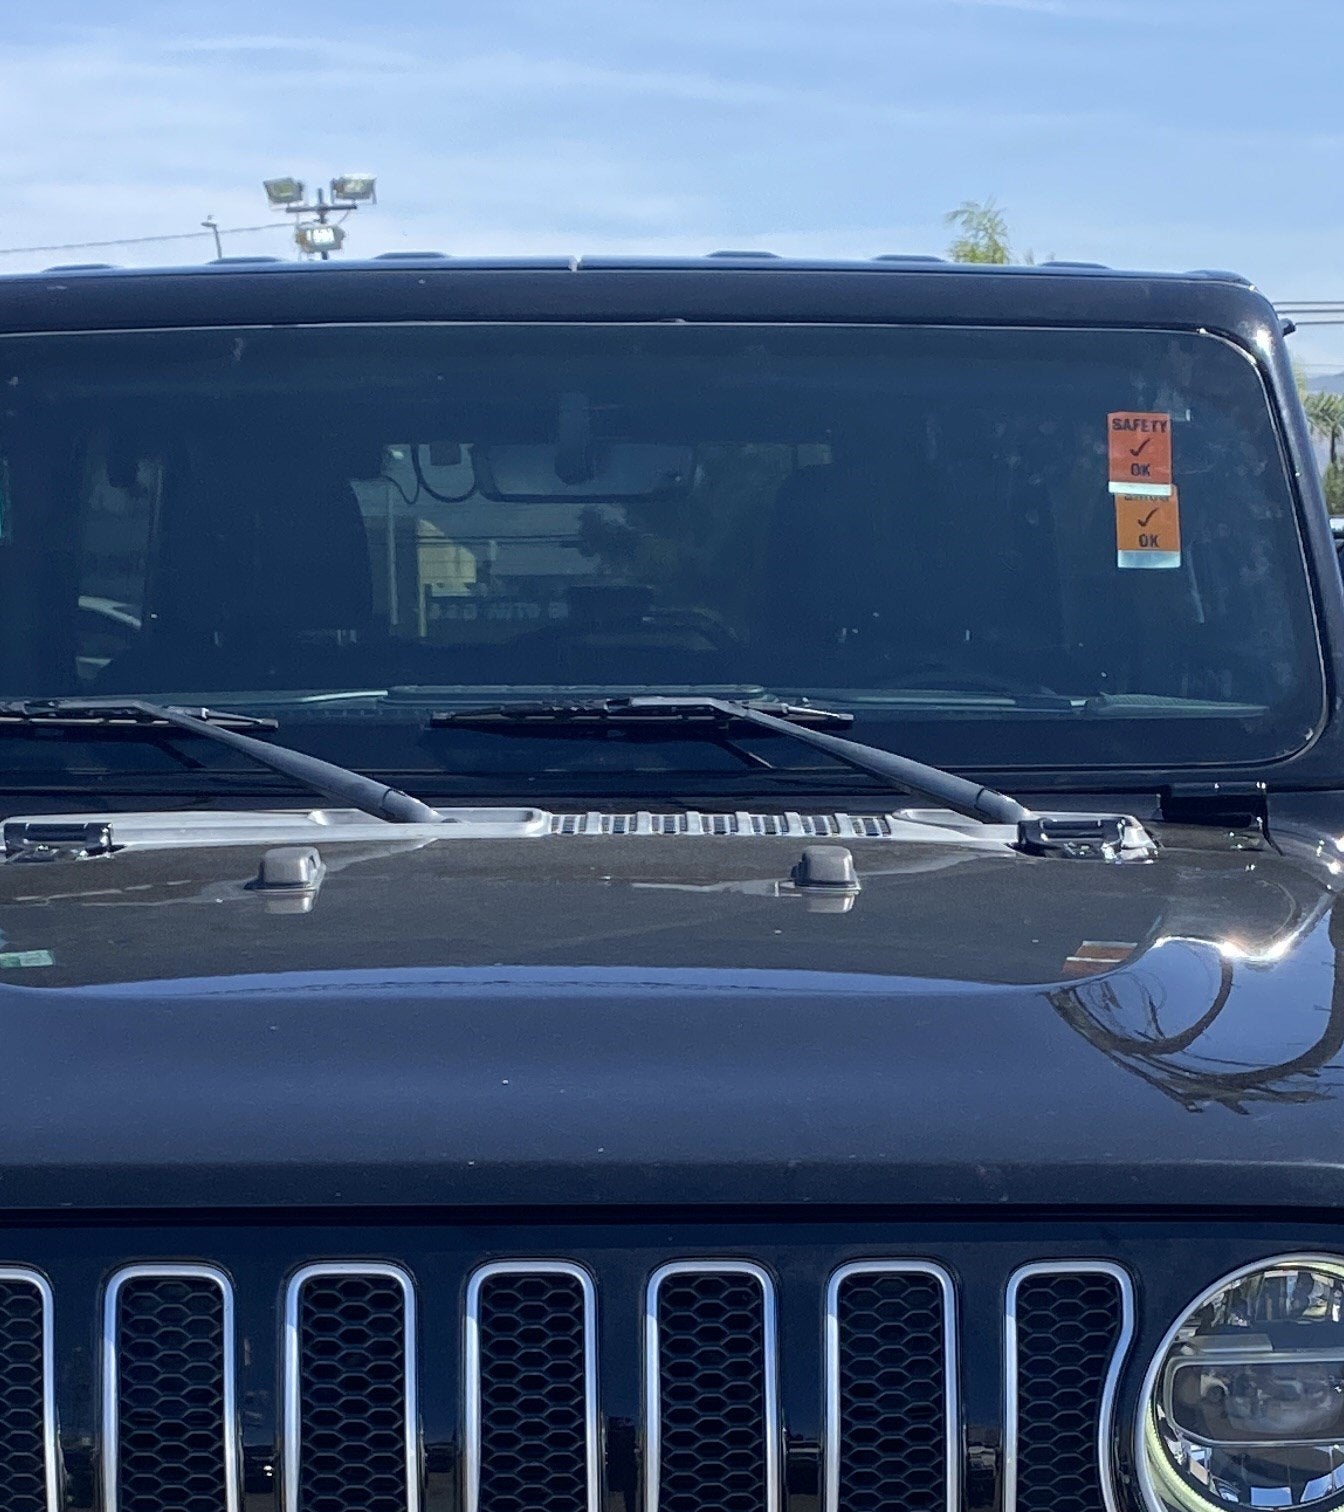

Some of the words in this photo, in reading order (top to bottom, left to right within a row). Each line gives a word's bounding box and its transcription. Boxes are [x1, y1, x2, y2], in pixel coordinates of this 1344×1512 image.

[1112, 418, 1168, 433] SAFETY
[1130, 463, 1151, 477] OK
[1138, 533, 1160, 548] OK
